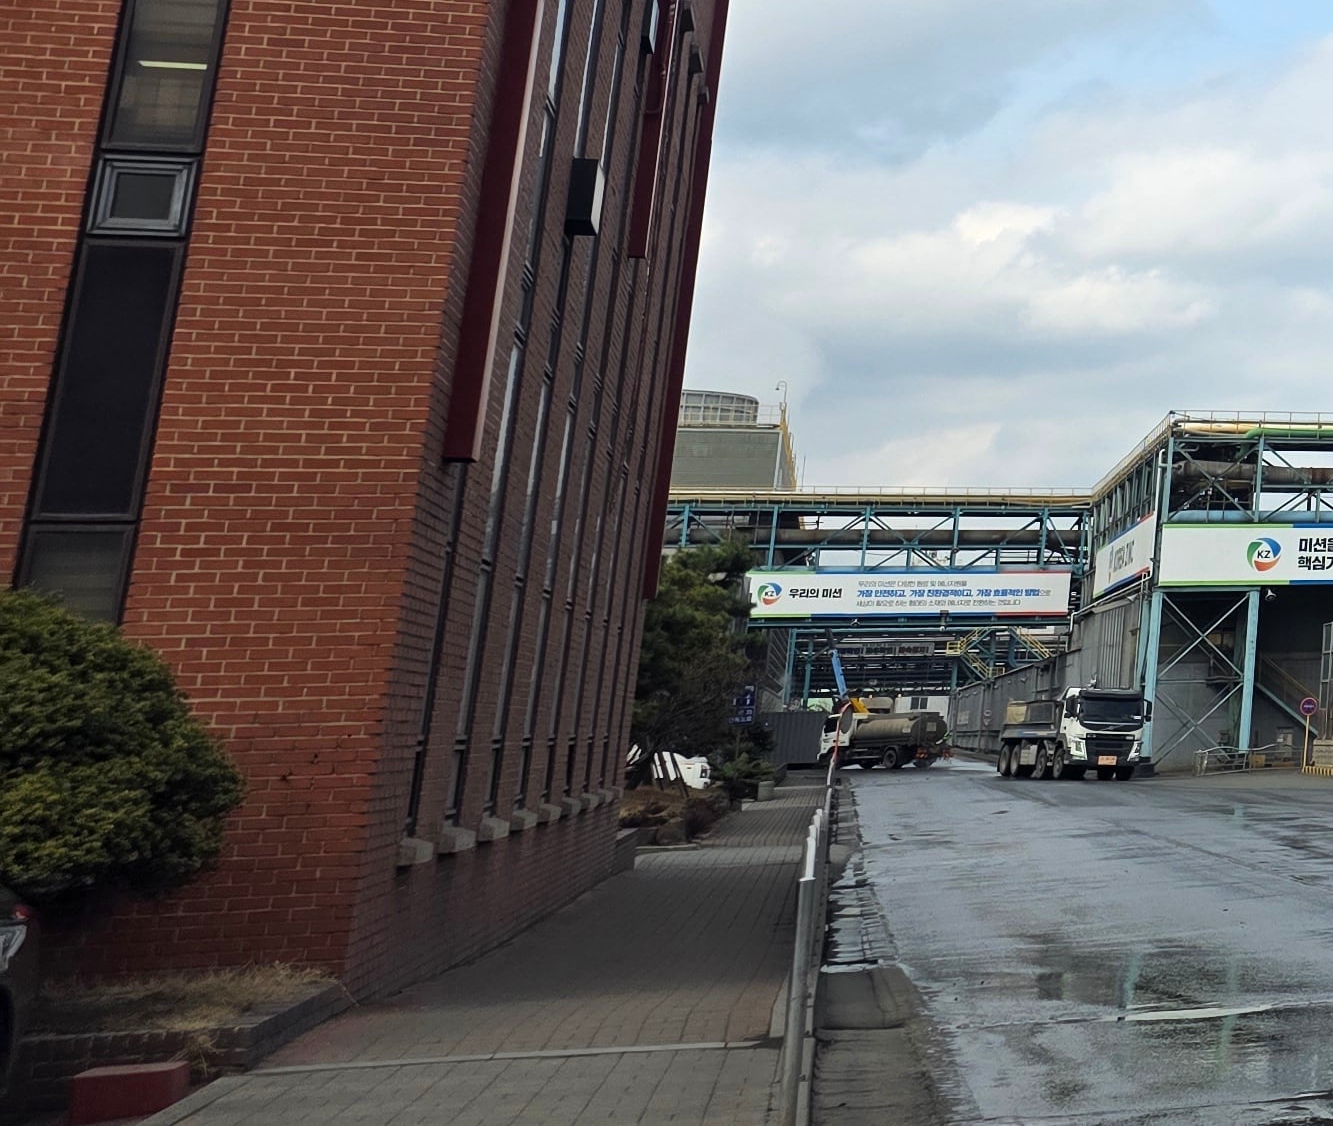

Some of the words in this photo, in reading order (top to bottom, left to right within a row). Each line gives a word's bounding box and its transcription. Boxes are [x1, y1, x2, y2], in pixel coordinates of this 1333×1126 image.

[1257, 550, 1271, 559] KZ
[789, 588, 819, 598] 우리의
[822, 588, 843, 598] 미션
[857, 589, 873, 598] 가장
[909, 589, 925, 597] 가장
[976, 589, 992, 597] 가장
[993, 589, 1023, 597] 효율적인
[1025, 589, 1051, 597] 방법으로
